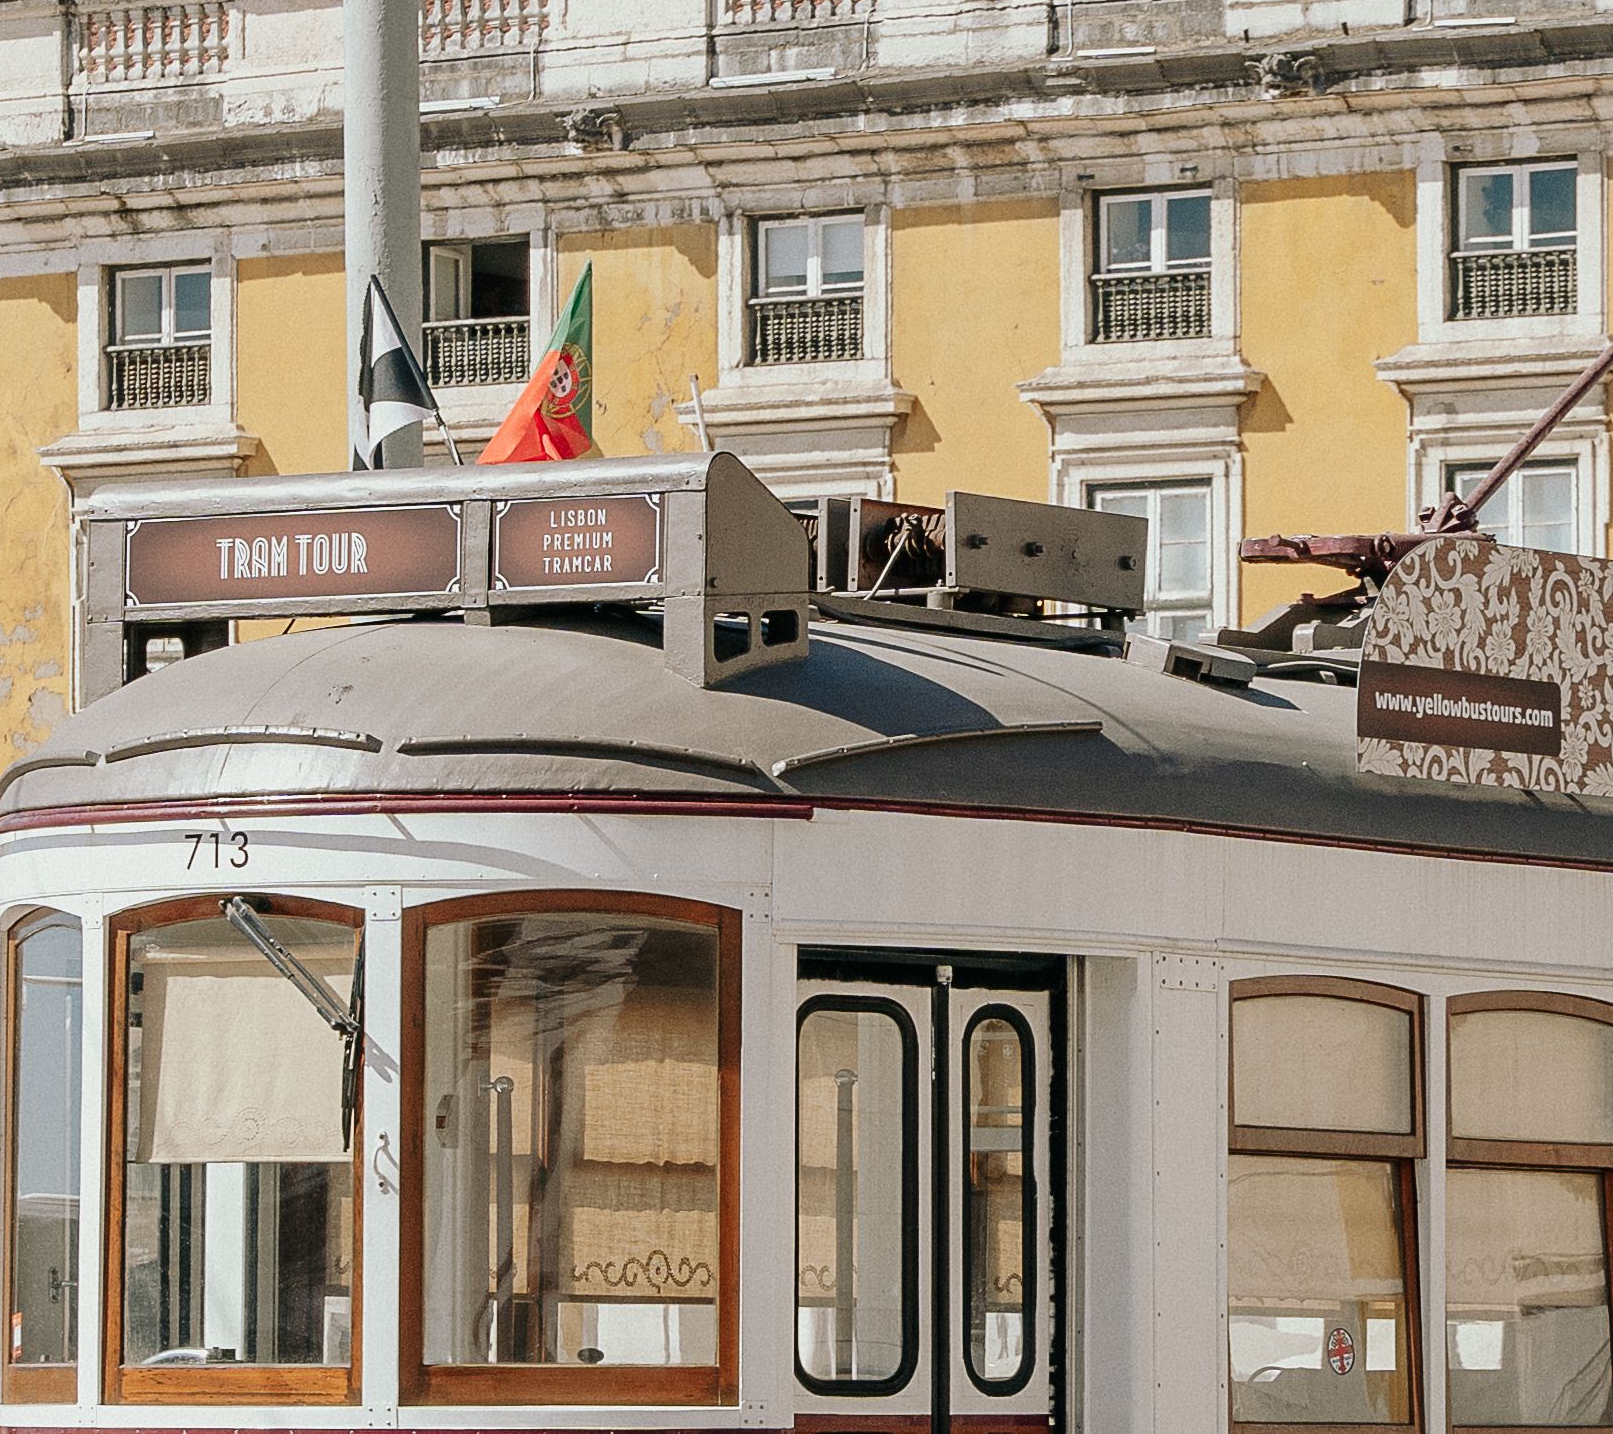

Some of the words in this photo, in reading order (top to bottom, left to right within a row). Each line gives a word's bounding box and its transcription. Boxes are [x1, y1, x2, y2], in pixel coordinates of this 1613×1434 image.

[550, 508, 607, 528] LISBON
[216, 535, 288, 579] TRAM
[294, 532, 369, 574] TOUR
[543, 531, 613, 551] PREMIUM
[543, 553, 613, 574] TRAMCAR
[1375, 691, 1554, 728] www.yellowbustours.com
[185, 831, 249, 870] 713
